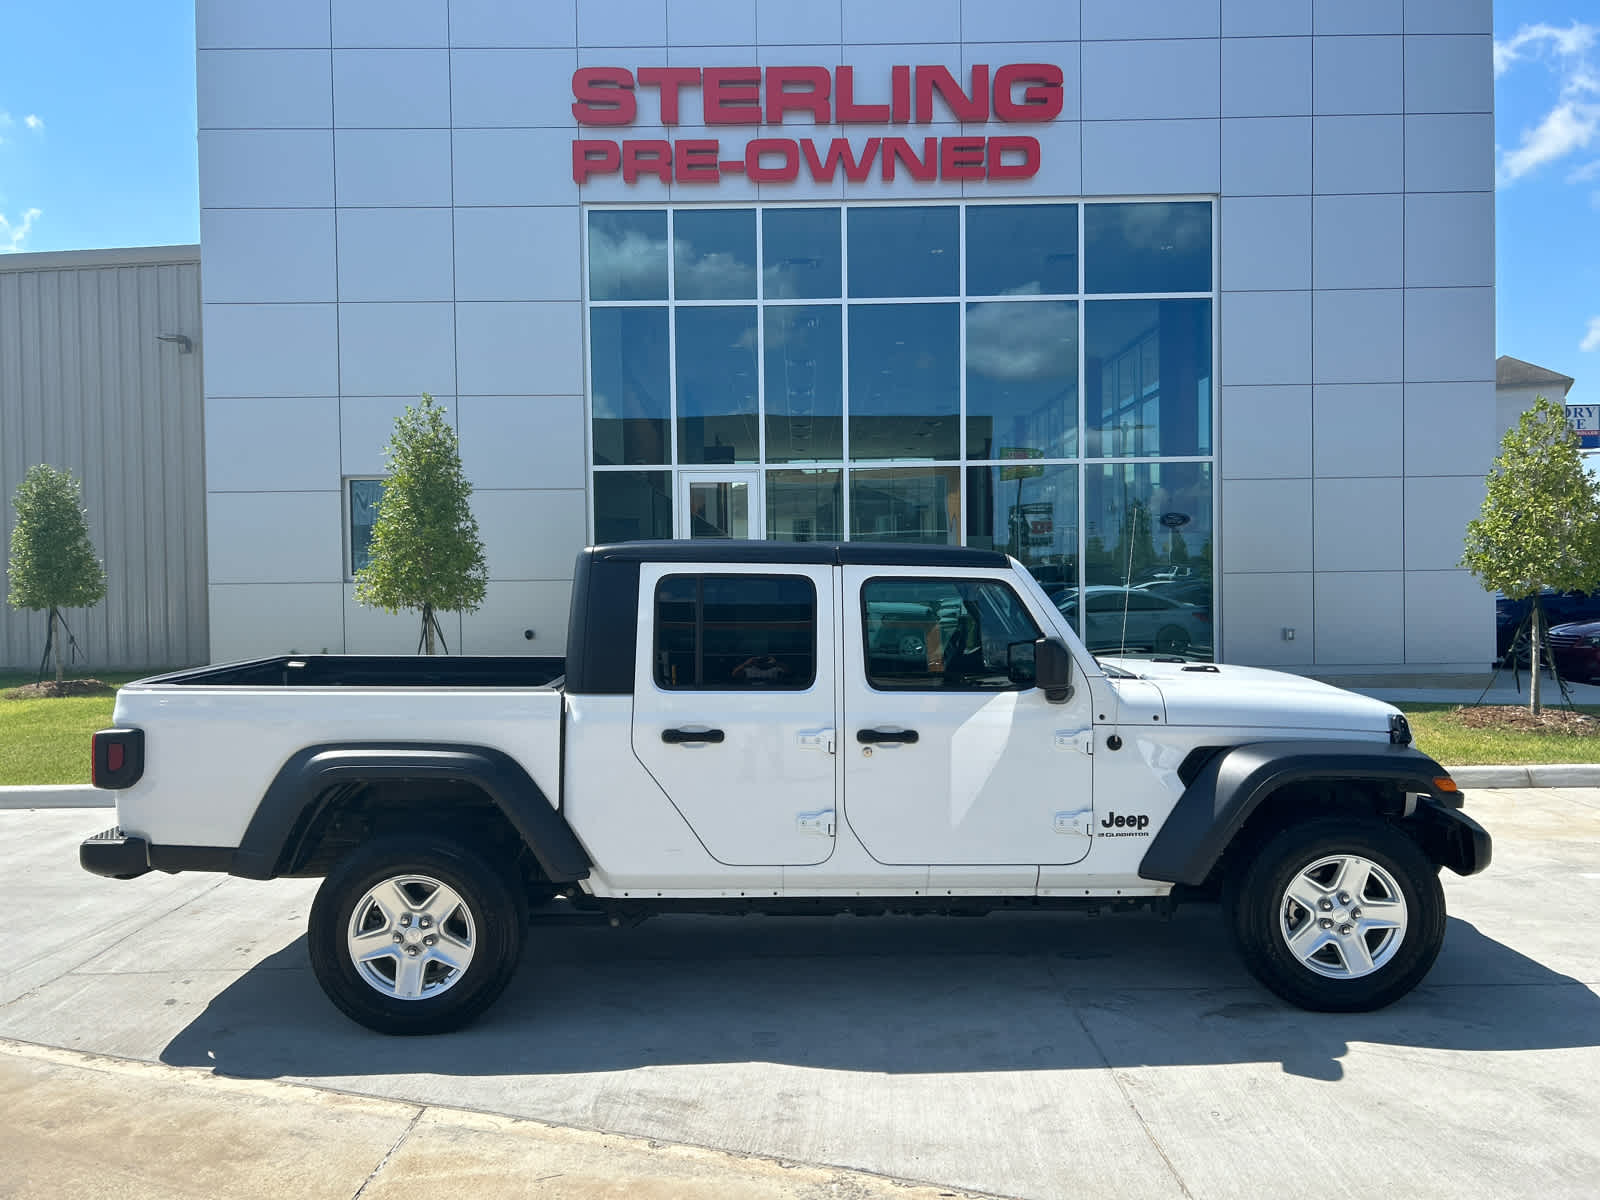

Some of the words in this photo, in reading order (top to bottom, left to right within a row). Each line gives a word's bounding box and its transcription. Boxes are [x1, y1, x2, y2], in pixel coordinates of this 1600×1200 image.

[572, 63, 1063, 125] STERLING
[572, 136, 1040, 184] PRE-OWNED
[1101, 811, 1149, 830] Jeep
